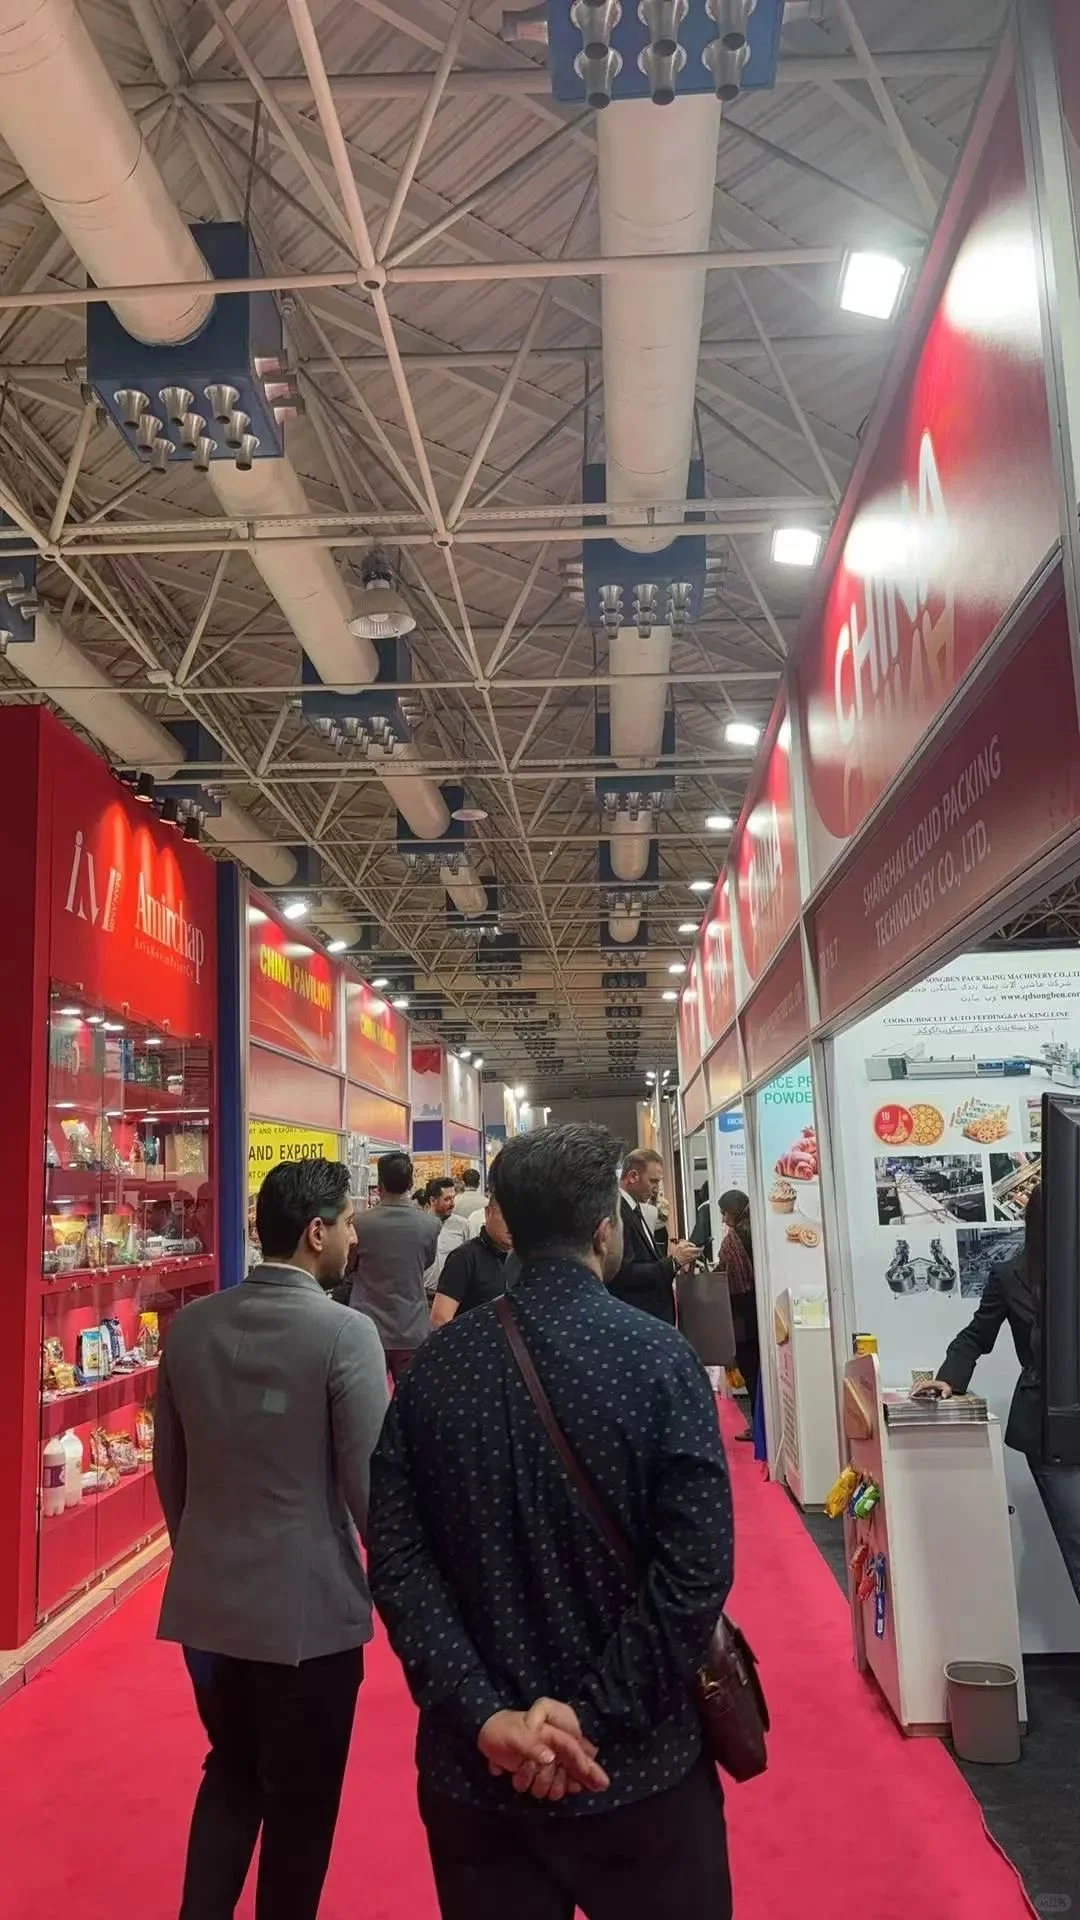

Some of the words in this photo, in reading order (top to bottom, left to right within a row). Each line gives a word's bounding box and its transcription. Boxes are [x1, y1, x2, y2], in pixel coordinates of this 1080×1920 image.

[862, 843, 906, 917] SHANGHAI
[905, 806, 942, 870] CLOUD
[942, 734, 1001, 832] PACKING
[874, 865, 936, 949] TECHNOLOGY
[961, 819, 991, 874] LTD.
[134, 871, 204, 984] Amirchap
[260, 943, 291, 990] CHINA
[293, 964, 332, 1012] PAVILION
[961, 973, 1006, 982] PACKAGING
[1007, 971, 1052, 980] MACHINERY
[769, 1076, 793, 1089] ICE
[248, 1145, 274, 1161] AND
[280, 1143, 324, 1160] EXPORT
[259, 1127, 271, 1135] AND
